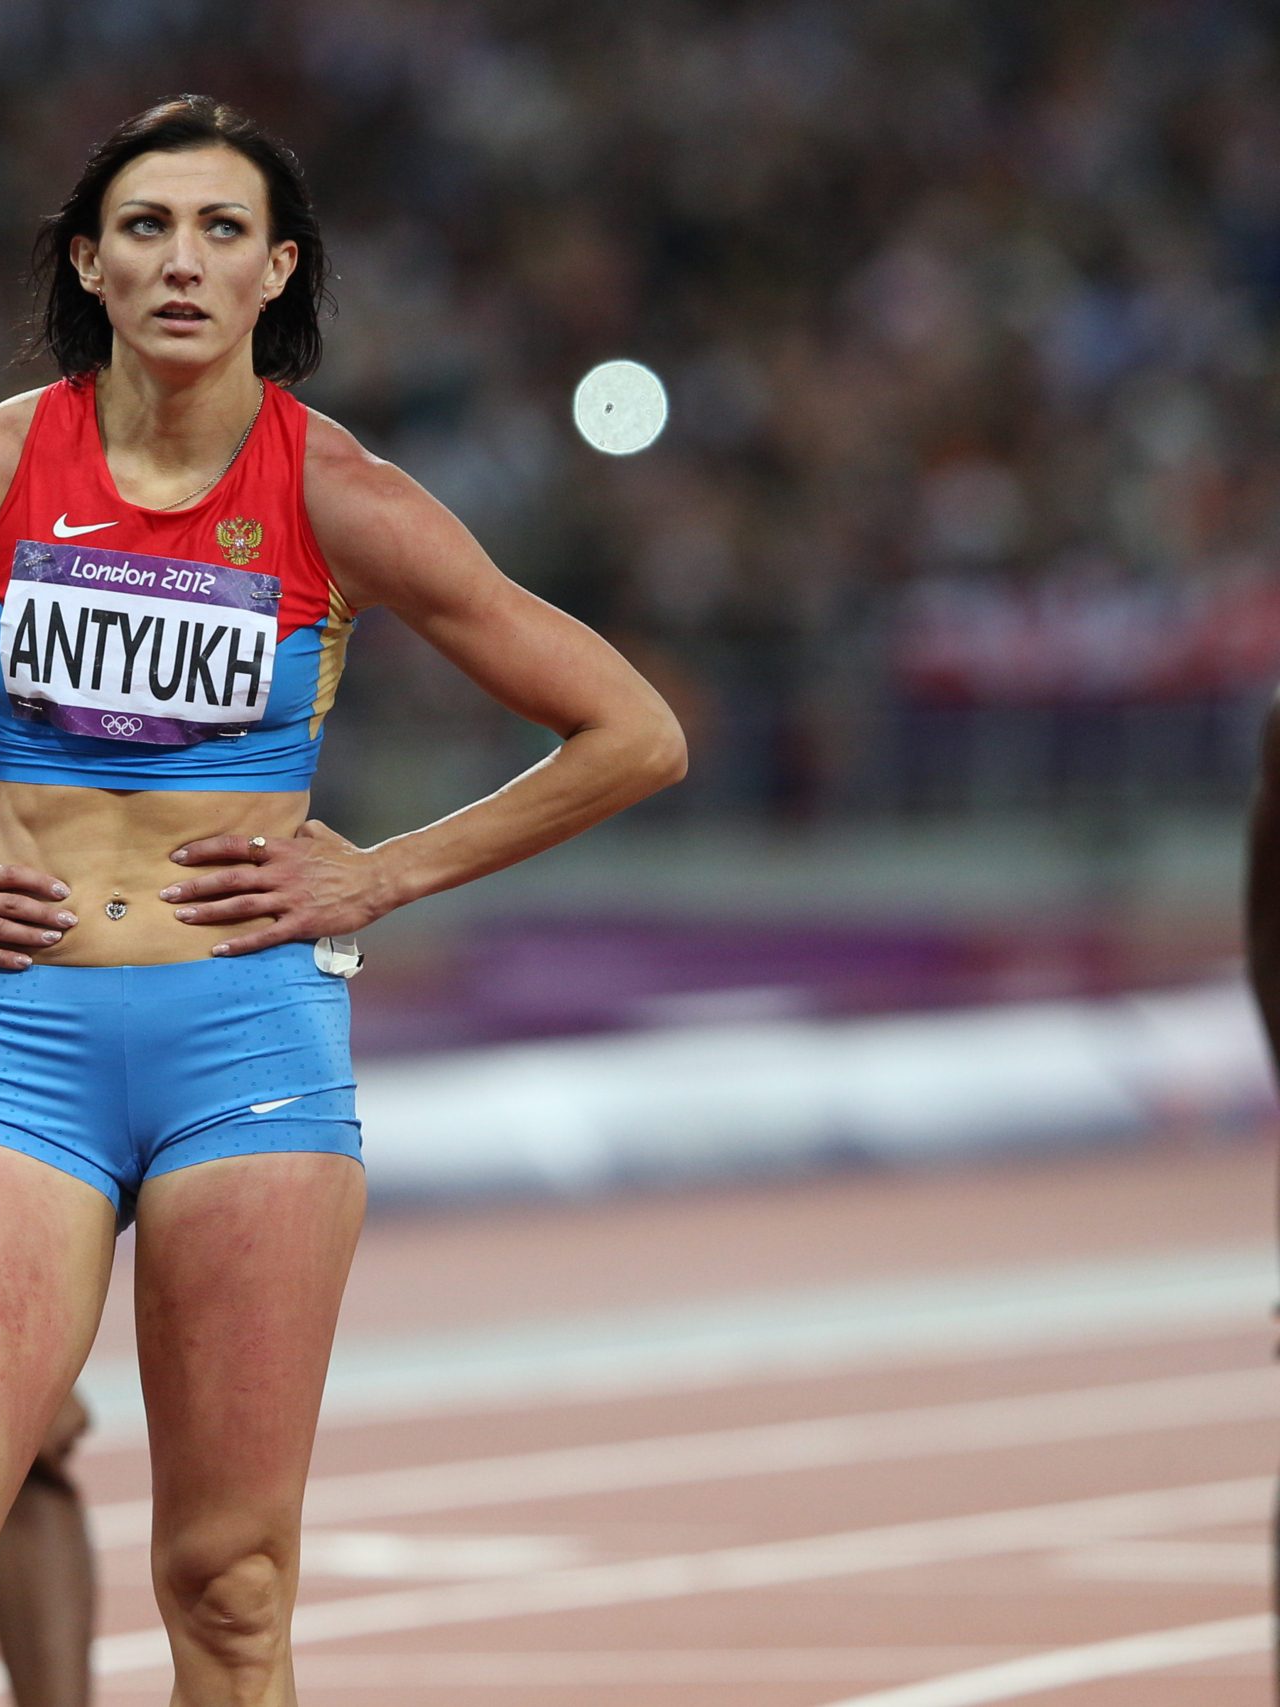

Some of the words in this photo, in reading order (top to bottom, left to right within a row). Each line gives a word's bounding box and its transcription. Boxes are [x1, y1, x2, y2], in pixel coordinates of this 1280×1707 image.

[70, 556, 155, 588] London
[161, 568, 217, 595] 2012
[9, 598, 266, 707] ANTYUKH
